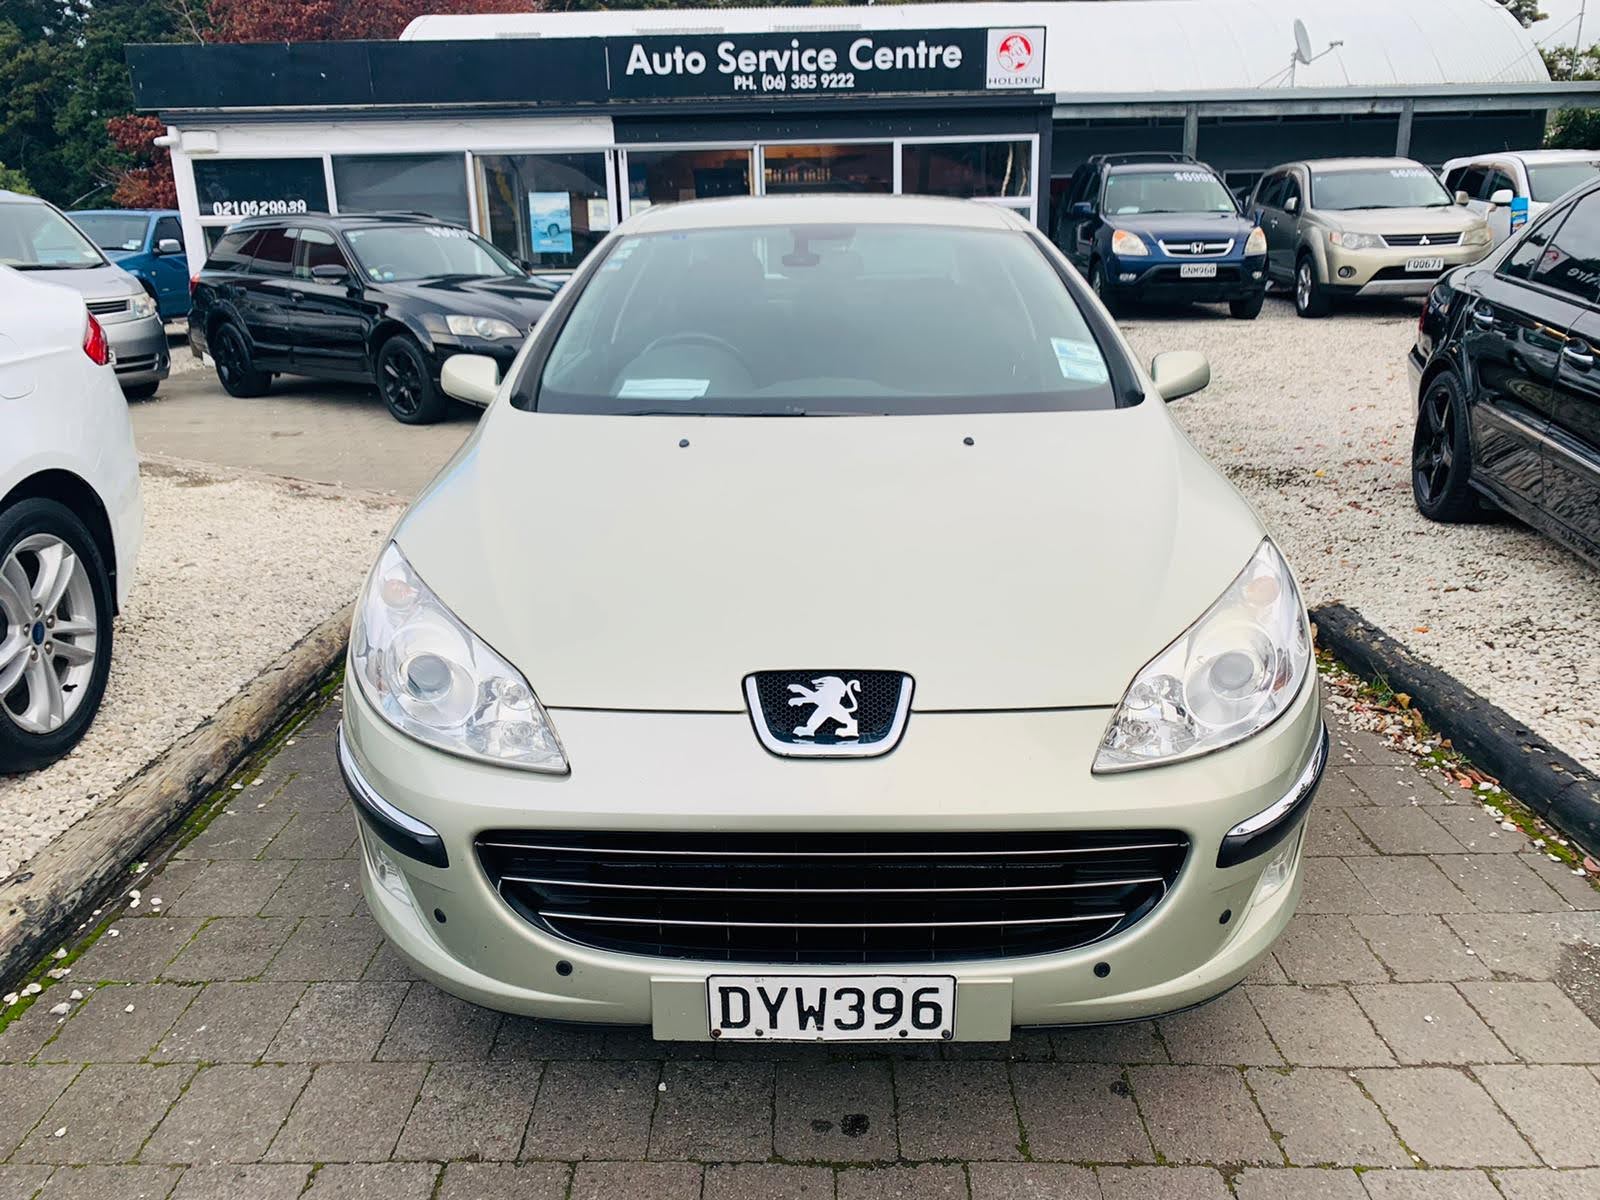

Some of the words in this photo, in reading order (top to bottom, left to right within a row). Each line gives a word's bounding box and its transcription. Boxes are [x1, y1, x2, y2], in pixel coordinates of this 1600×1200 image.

[625, 43, 706, 76] Auto
[717, 38, 838, 74] Service
[849, 37, 963, 71] Centre
[733, 74, 757, 91] PH.
[761, 72, 786, 92] (06)
[790, 73, 817, 89] 385
[820, 72, 855, 89] 9222
[988, 76, 1041, 86] HOLDEN
[717, 985, 944, 1031] DYW396
